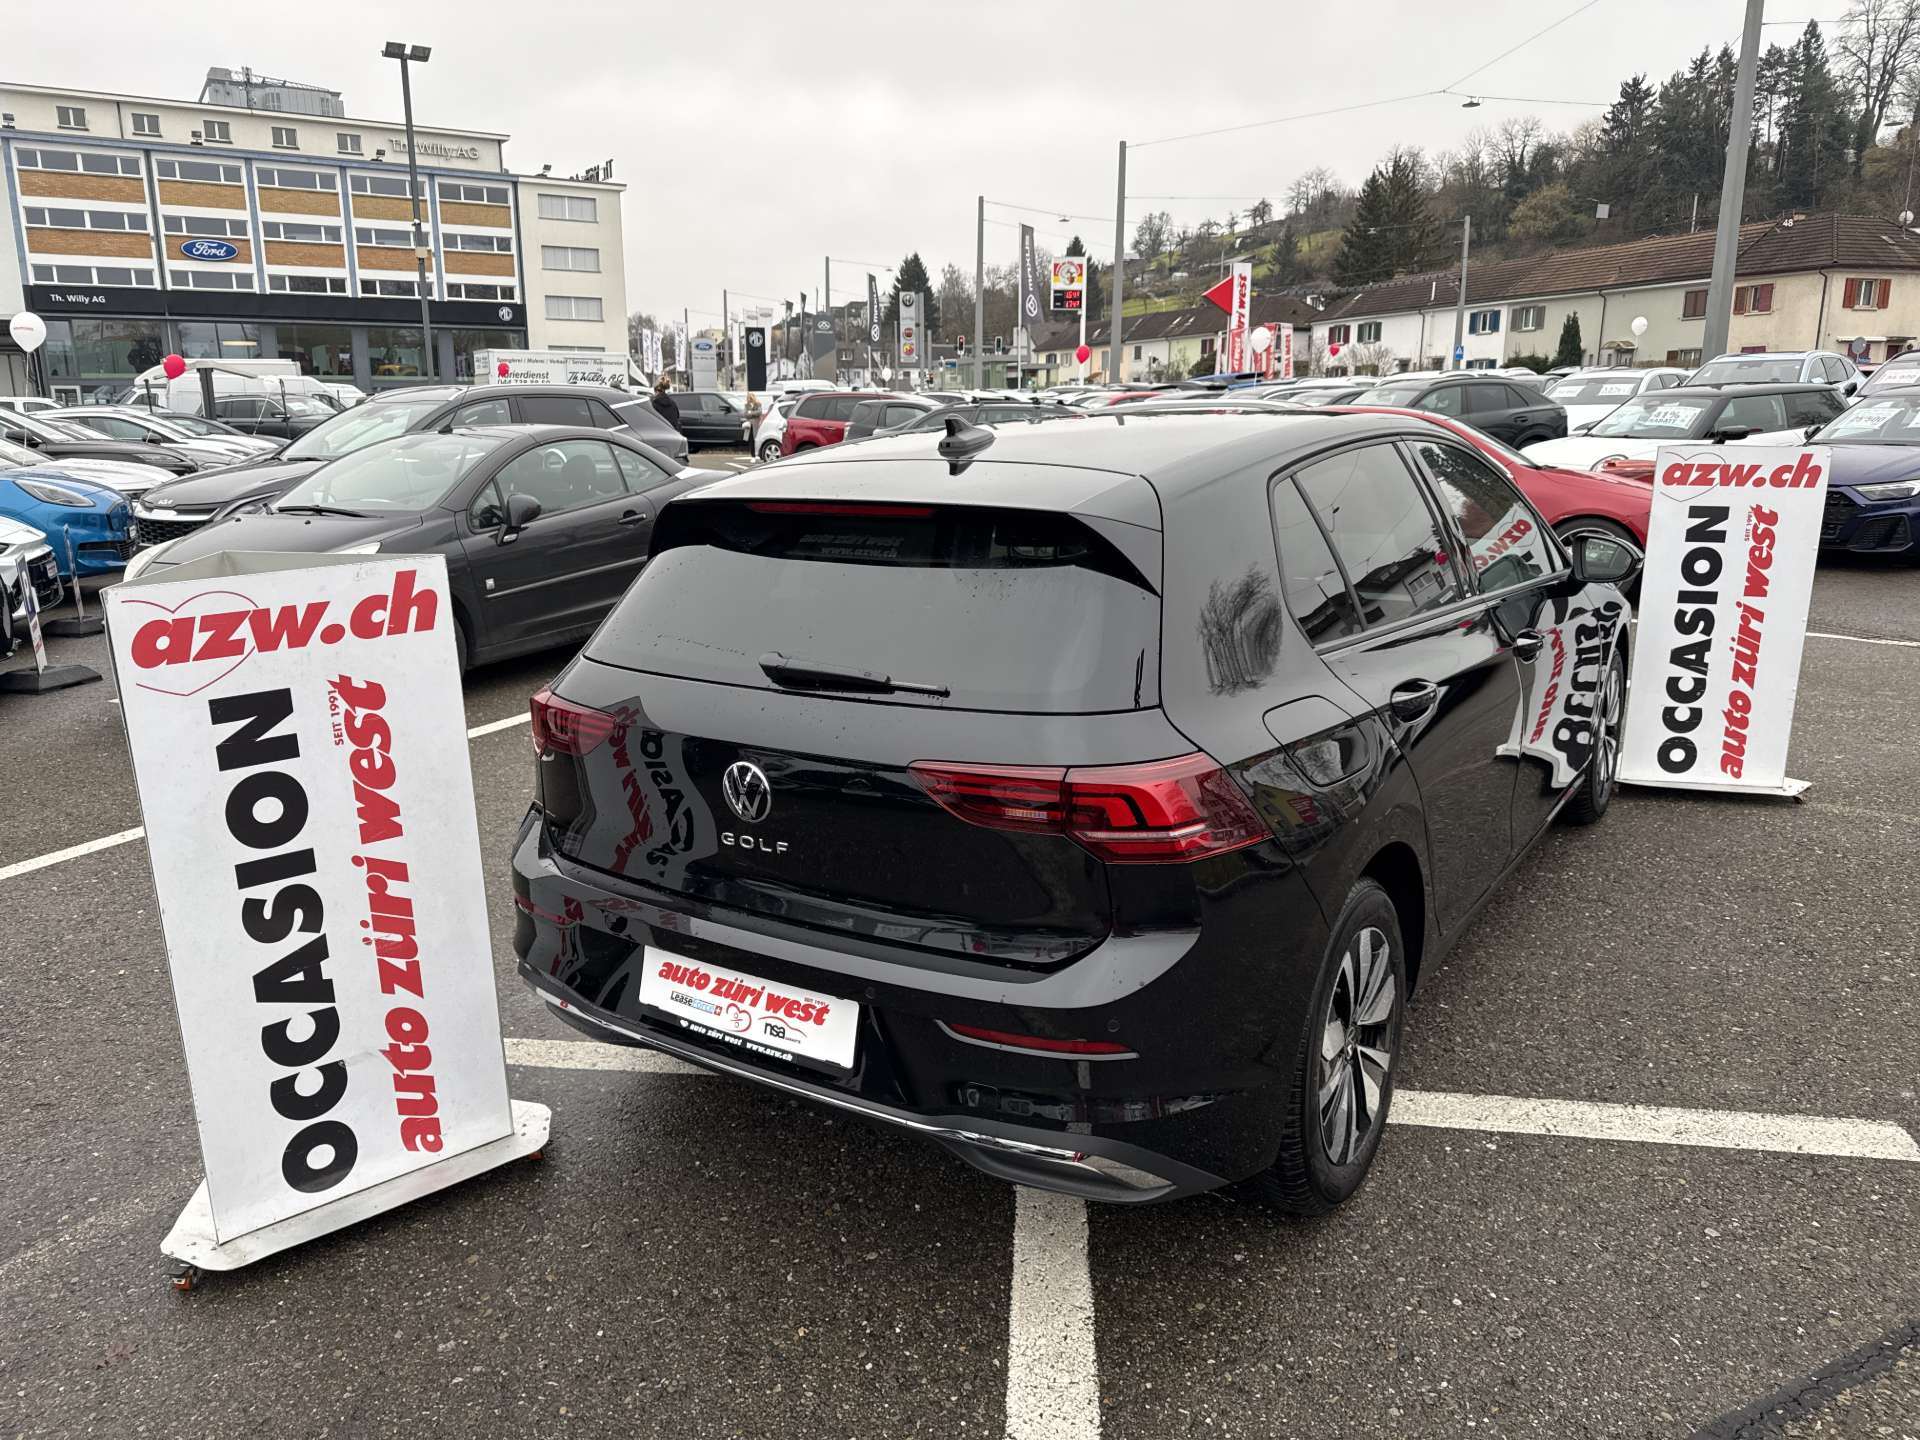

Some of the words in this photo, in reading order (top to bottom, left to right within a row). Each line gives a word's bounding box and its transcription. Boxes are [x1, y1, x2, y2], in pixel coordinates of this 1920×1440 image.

[418, 143, 453, 160] Willy
[456, 147, 480, 160] AG
[1783, 219, 1793, 227] 48
[192, 242, 226, 257] Ford
[50, 294, 65, 302] Th.
[67, 295, 90, 304] Willy
[498, 370, 549, 380] rierdienst
[1663, 453, 1822, 488] azw.ch
[1744, 504, 1778, 598] west
[131, 571, 438, 668] azw.ch
[1658, 506, 1729, 774] OCCASION
[1729, 601, 1765, 690] züri
[328, 689, 340, 717] 1991
[332, 722, 344, 747] SEIT
[1720, 690, 1753, 779] auto
[327, 674, 404, 845] west
[721, 831, 789, 855] GOLF
[209, 687, 358, 1193] OCCASION
[351, 856, 424, 998] züri
[658, 961, 711, 991] auto
[709, 977, 765, 1007] züri
[765, 992, 831, 1026] west
[690, 1023, 706, 1035] auto
[707, 1028, 723, 1041] züri
[724, 1034, 743, 1046] west
[746, 1041, 793, 1061] www.azw.ch
[764, 1023, 786, 1040] nsa
[380, 1006, 444, 1153] auto
